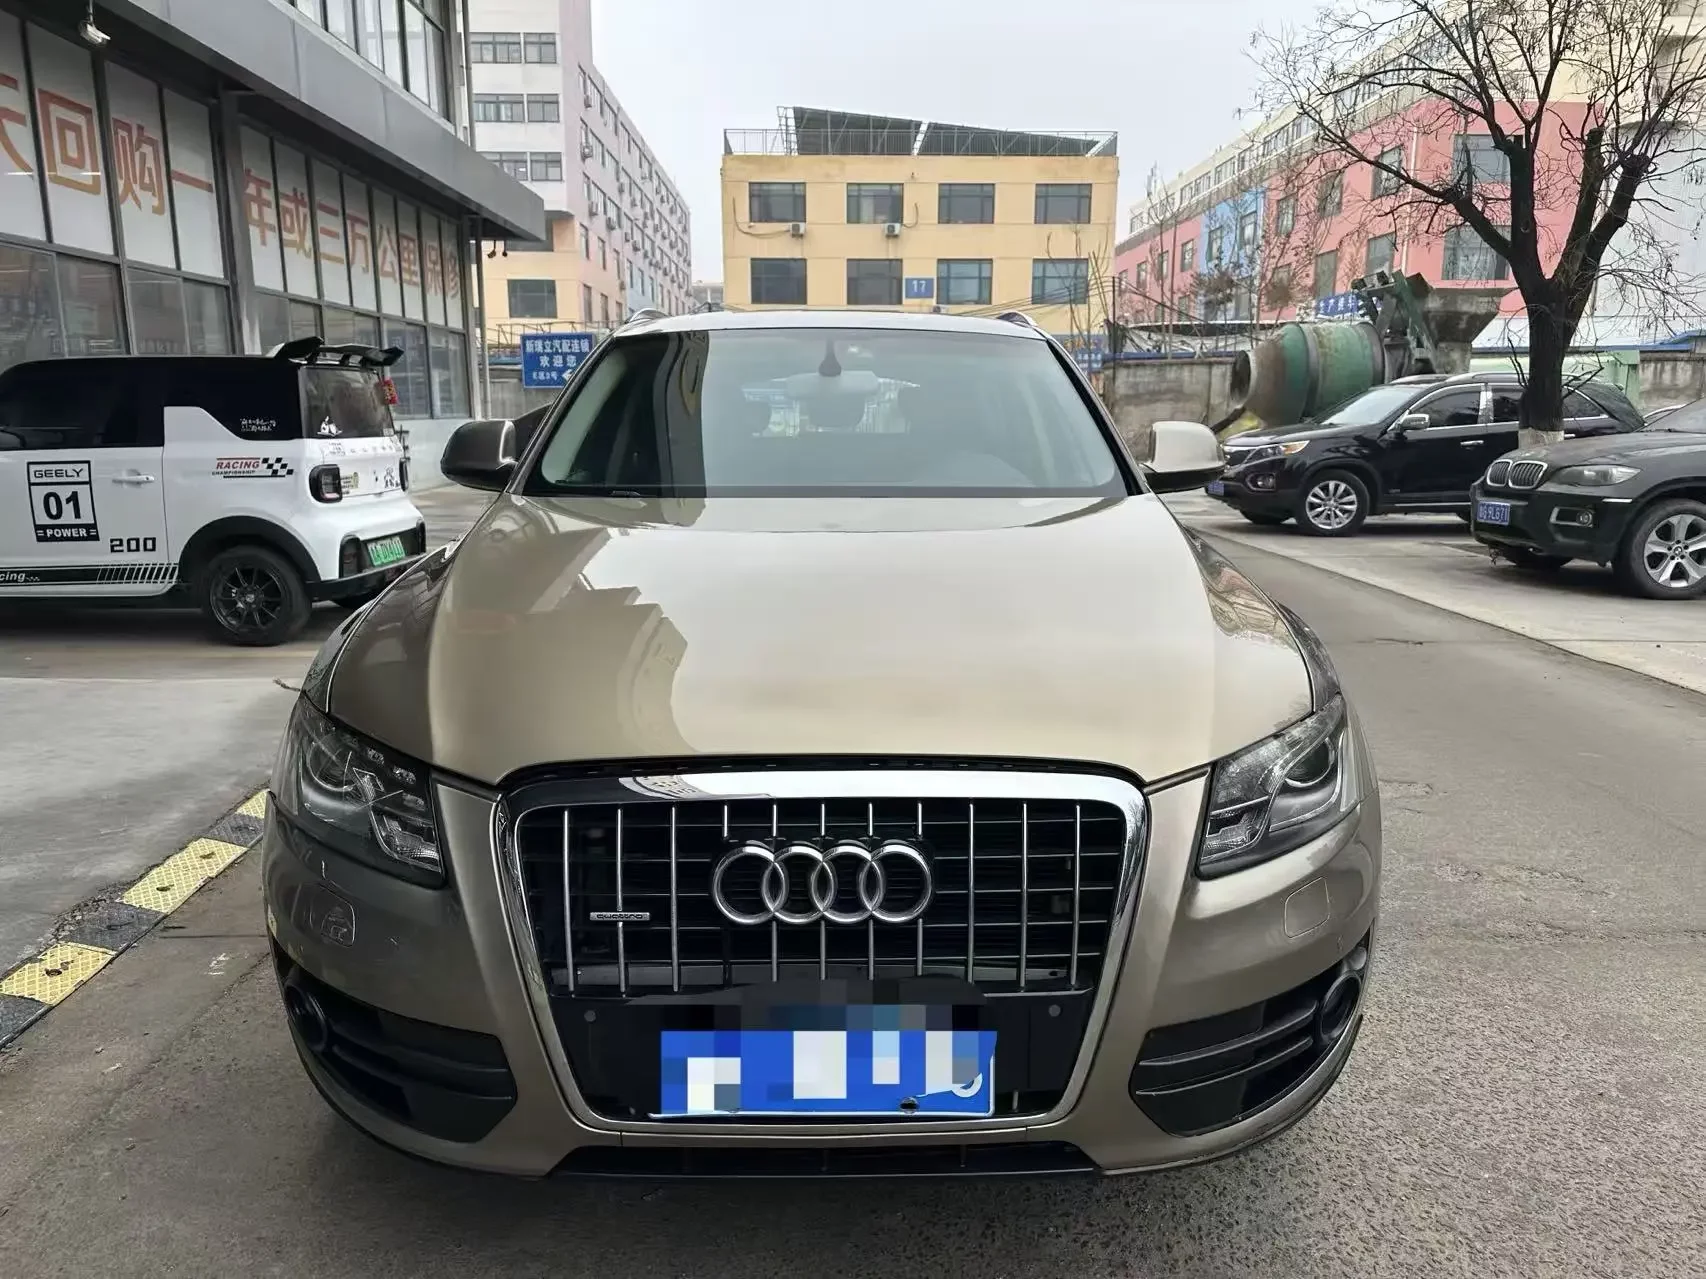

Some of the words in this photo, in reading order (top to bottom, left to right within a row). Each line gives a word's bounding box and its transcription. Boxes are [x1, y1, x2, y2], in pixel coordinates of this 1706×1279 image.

[912, 280, 927, 292] 17
[216, 461, 260, 469] RACING
[33, 468, 84, 478] GEELY
[43, 490, 82, 520] 01
[46, 528, 88, 538] POWER
[109, 537, 157, 553] 200
